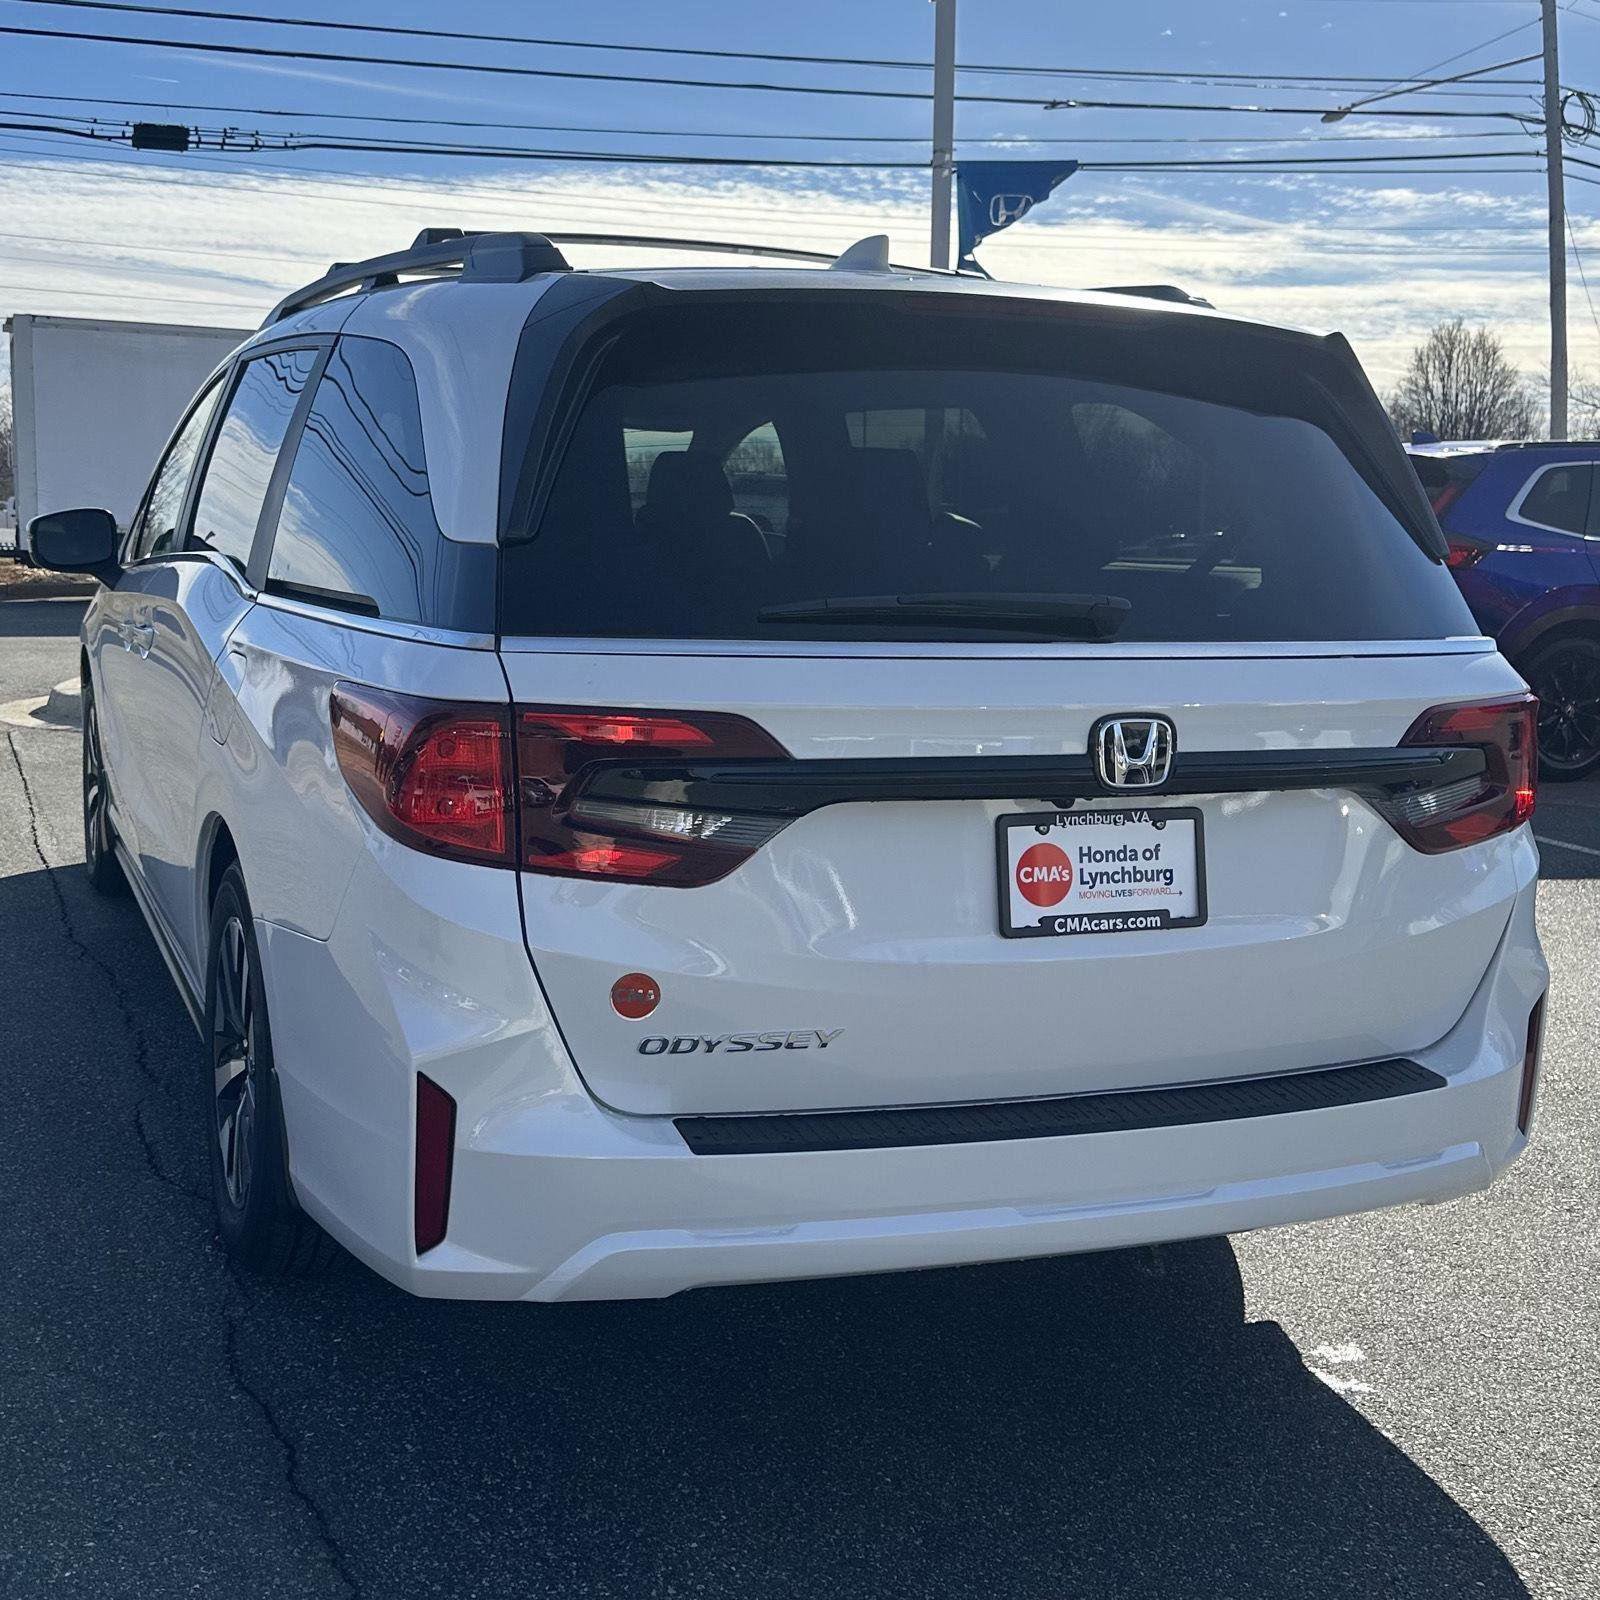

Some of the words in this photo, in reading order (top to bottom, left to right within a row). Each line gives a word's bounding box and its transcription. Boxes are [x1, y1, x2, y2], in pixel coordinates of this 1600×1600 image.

[1131, 811, 1150, 823] VA
[1079, 845, 1138, 864] Honda
[1142, 843, 1161, 861] of
[1019, 866, 1070, 883] CMA's
[1079, 866, 1174, 889] Lynchburg
[1054, 915, 1161, 933] CMAcars.com
[637, 1028, 845, 1056] ODYSSEY
